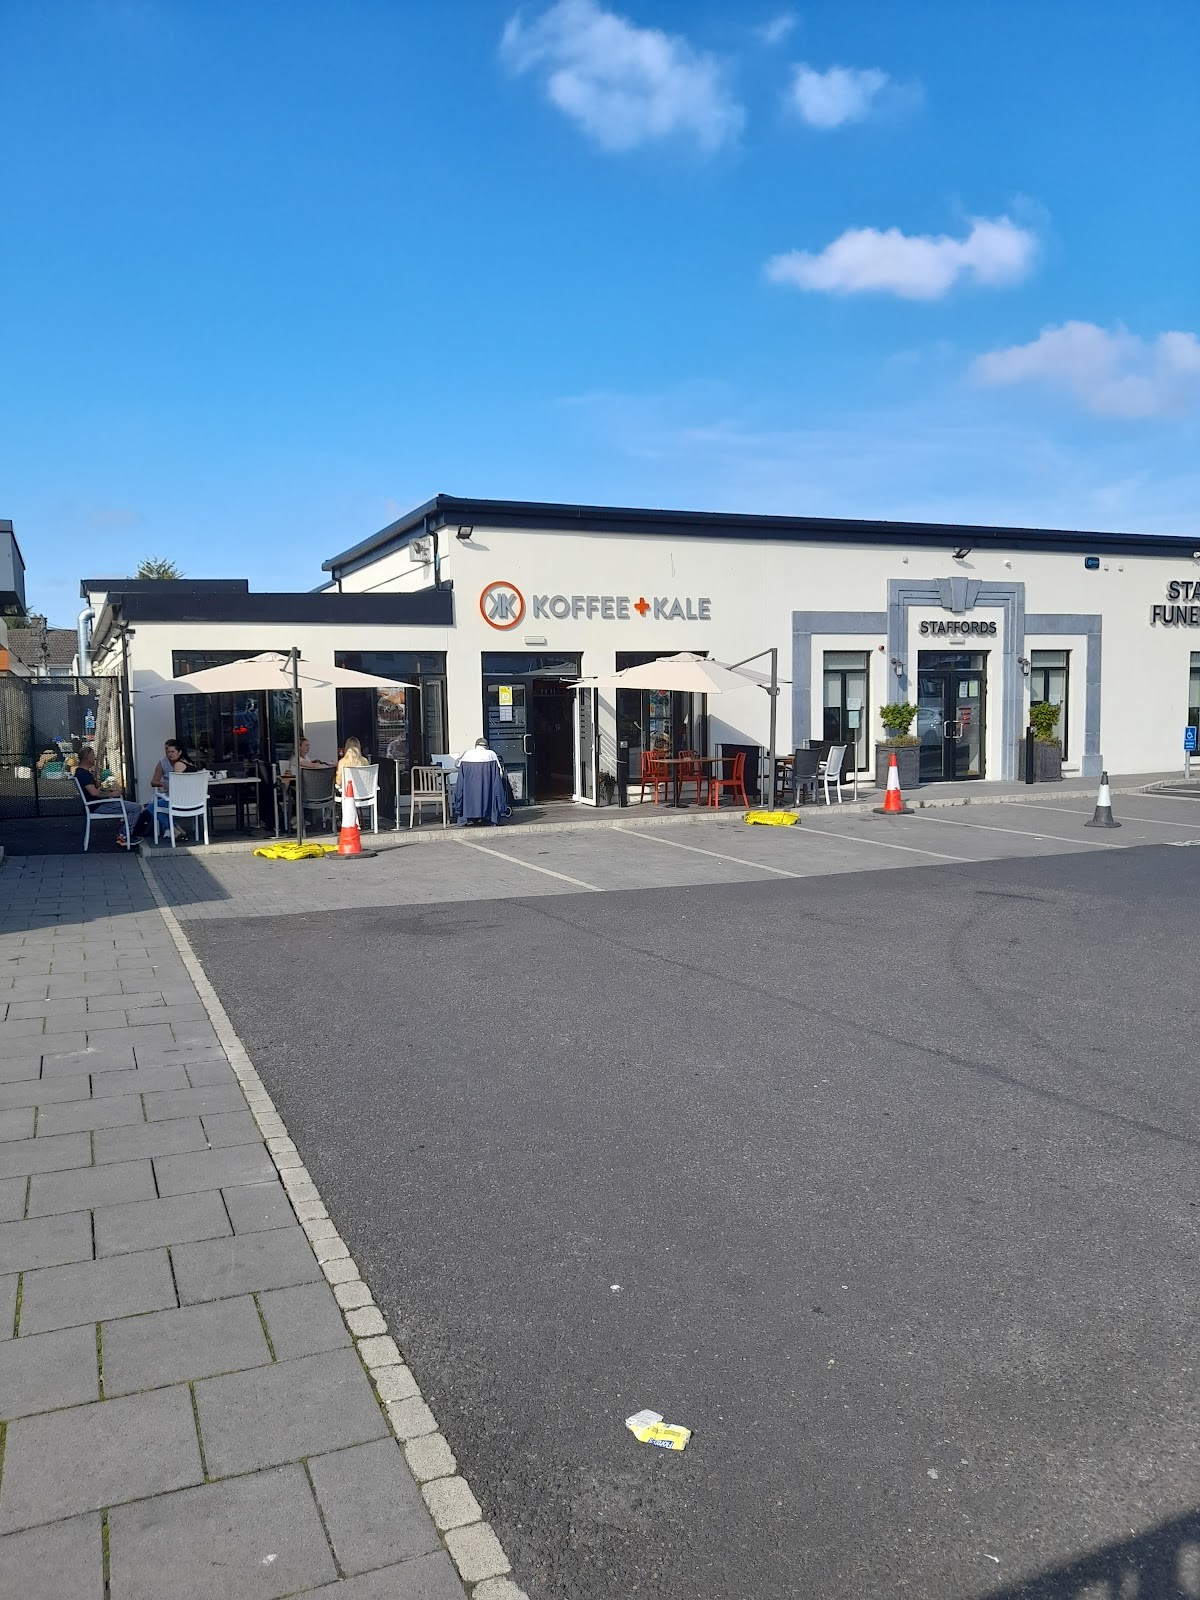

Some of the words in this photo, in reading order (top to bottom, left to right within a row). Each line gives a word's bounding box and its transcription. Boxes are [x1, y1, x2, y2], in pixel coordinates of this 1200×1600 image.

[532, 594, 630, 620] KOFFEE
[653, 597, 711, 620] KALE
[920, 620, 997, 635] STAFFORDS
